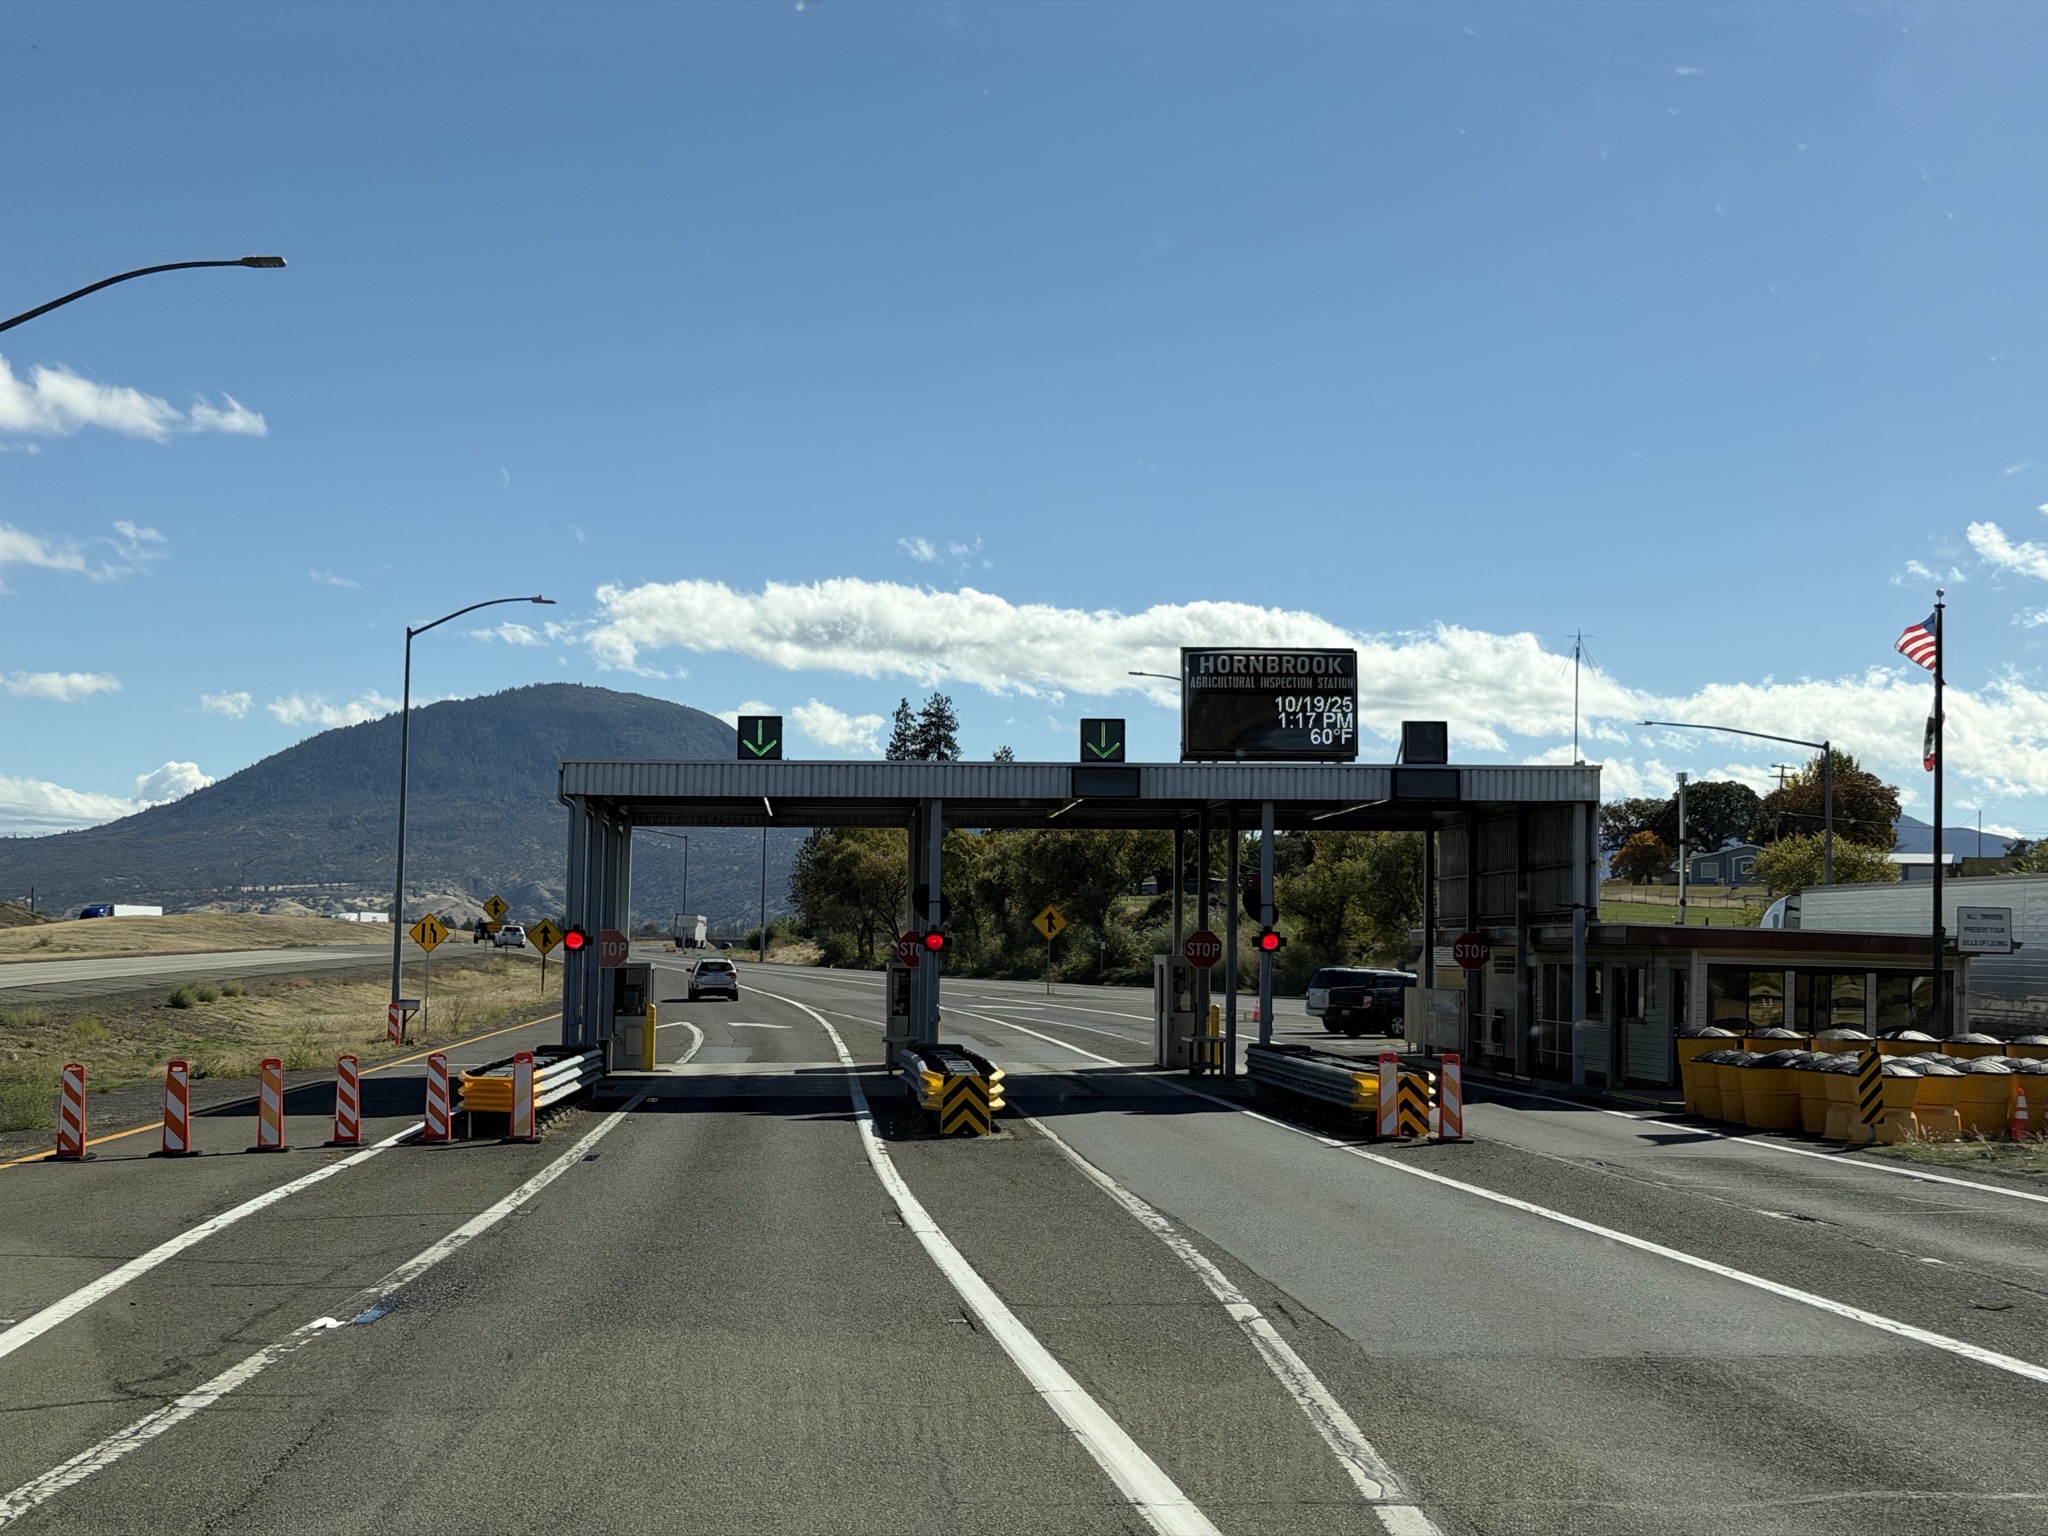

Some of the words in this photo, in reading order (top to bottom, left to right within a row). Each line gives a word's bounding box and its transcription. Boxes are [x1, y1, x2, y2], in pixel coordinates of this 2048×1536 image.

[1199, 656, 1343, 674] HORNBROOK
[1190, 676, 1255, 689] AGRICULTURAL
[1260, 676, 1313, 689] INSPECTION
[1317, 676, 1353, 689] STATION
[1275, 696, 1353, 713] 10/19/25
[1278, 713, 1316, 729] 1:17
[1323, 713, 1353, 729] PM
[1310, 729, 1353, 745] 60°F
[600, 941, 627, 957] TOP
[1186, 942, 1220, 957] STOP
[1455, 944, 1489, 959] STOP
